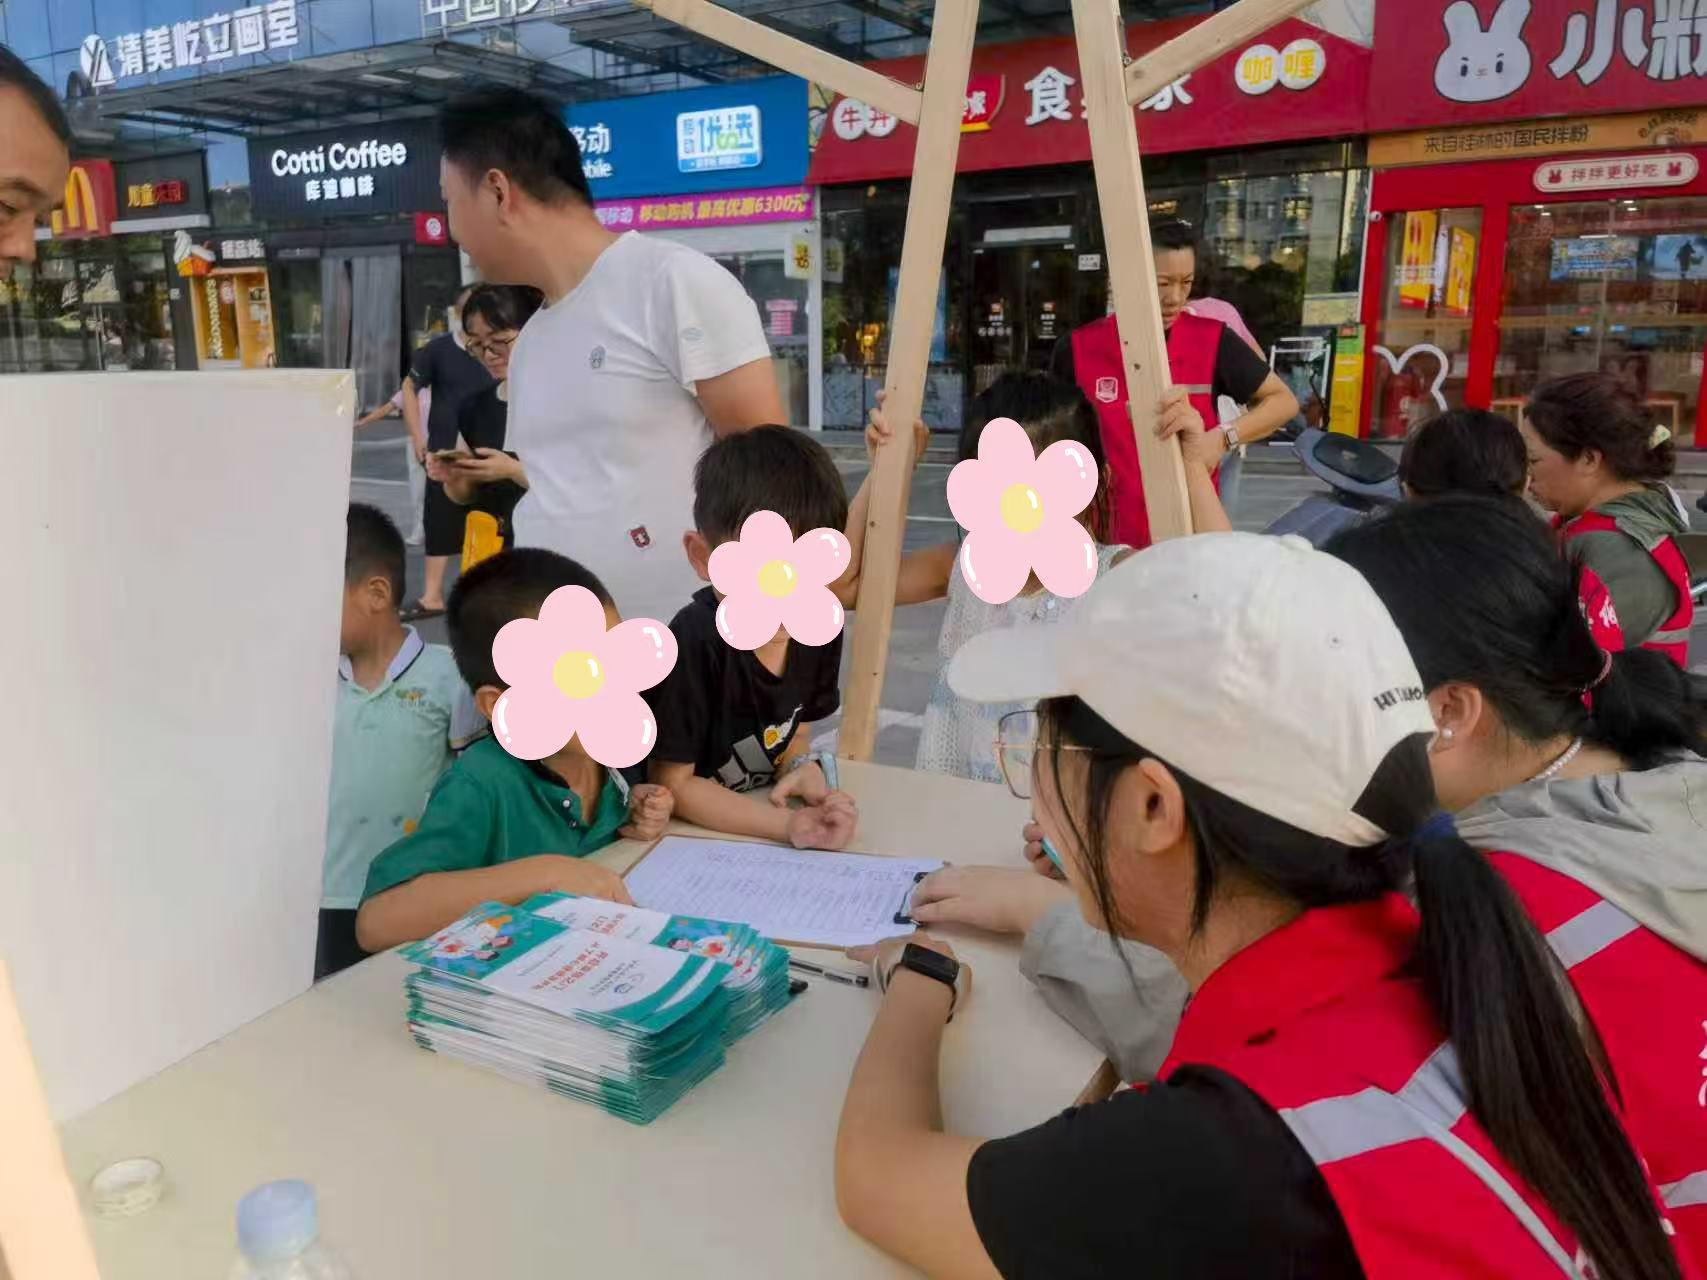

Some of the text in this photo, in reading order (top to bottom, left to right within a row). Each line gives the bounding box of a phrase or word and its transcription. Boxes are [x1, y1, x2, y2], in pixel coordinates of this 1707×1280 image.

[271, 139, 407, 177] Cotti Coffee
[305, 174, 374, 201] 库迪咖啡
